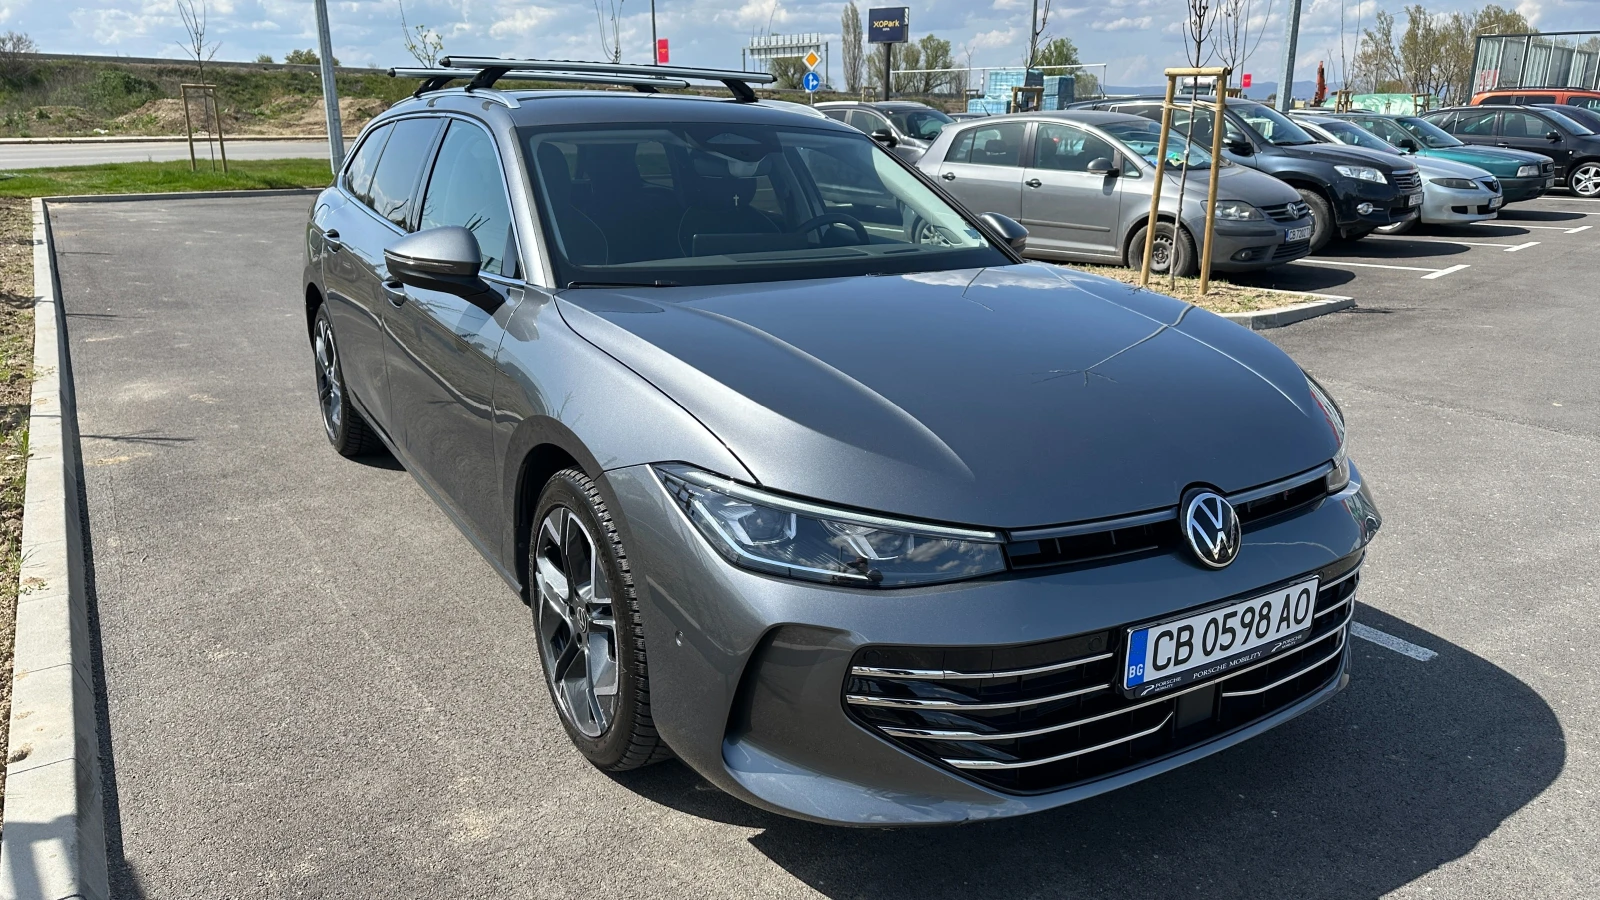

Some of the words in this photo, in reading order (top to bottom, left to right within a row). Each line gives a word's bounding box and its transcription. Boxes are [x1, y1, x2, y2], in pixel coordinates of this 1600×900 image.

[873, 19, 900, 28] XOPark
[1152, 624, 1194, 672] CB
[1202, 600, 1272, 657] 0598
[1275, 587, 1311, 634] AO
[1282, 634, 1303, 646] PORSCHE
[1129, 663, 1144, 679] BG
[1193, 662, 1227, 680] PORSCHE
[1229, 650, 1263, 668] MOBILITY
[1155, 677, 1181, 688] PORSCHE
